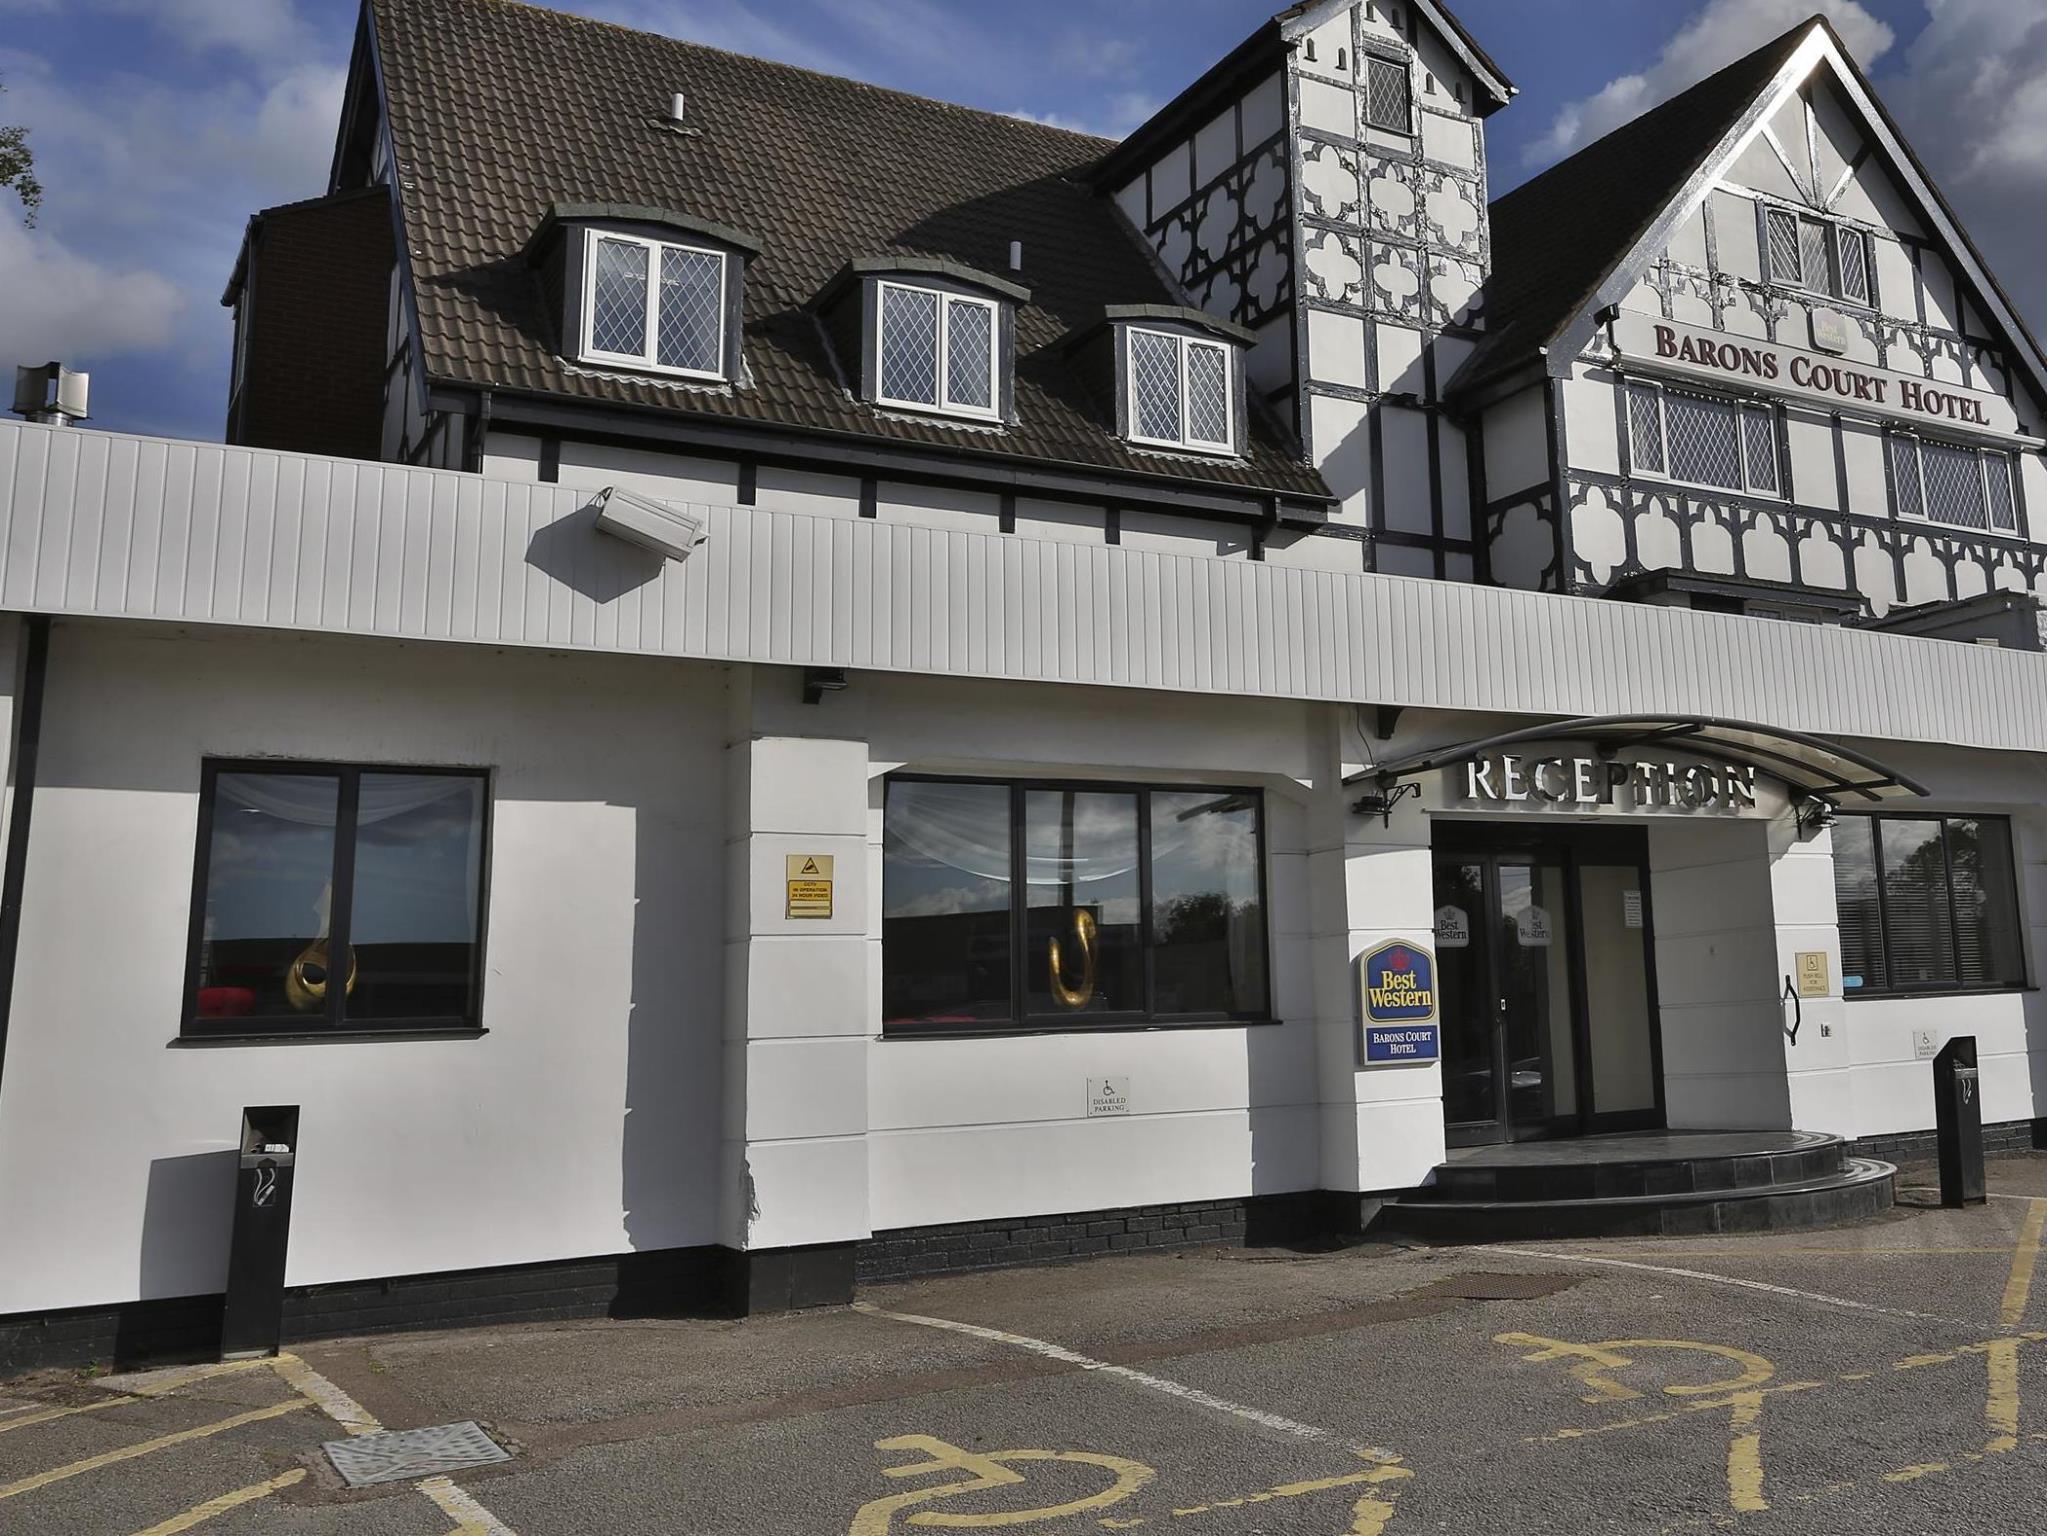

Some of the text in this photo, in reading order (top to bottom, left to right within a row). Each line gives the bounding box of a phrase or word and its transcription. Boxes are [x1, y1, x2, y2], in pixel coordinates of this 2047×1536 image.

[1653, 325, 1990, 426] BARONS COURT HOTEL
[1467, 755, 1756, 808] RECEPTION
[1440, 919, 1459, 930] Best
[1381, 970, 1416, 990] Best
[1369, 987, 1432, 1008] Western
[1373, 1031, 1432, 1043] BARONS COURT
[1390, 1044, 1417, 1054] HOTEL
[1093, 1097, 1126, 1105] DISABLED
